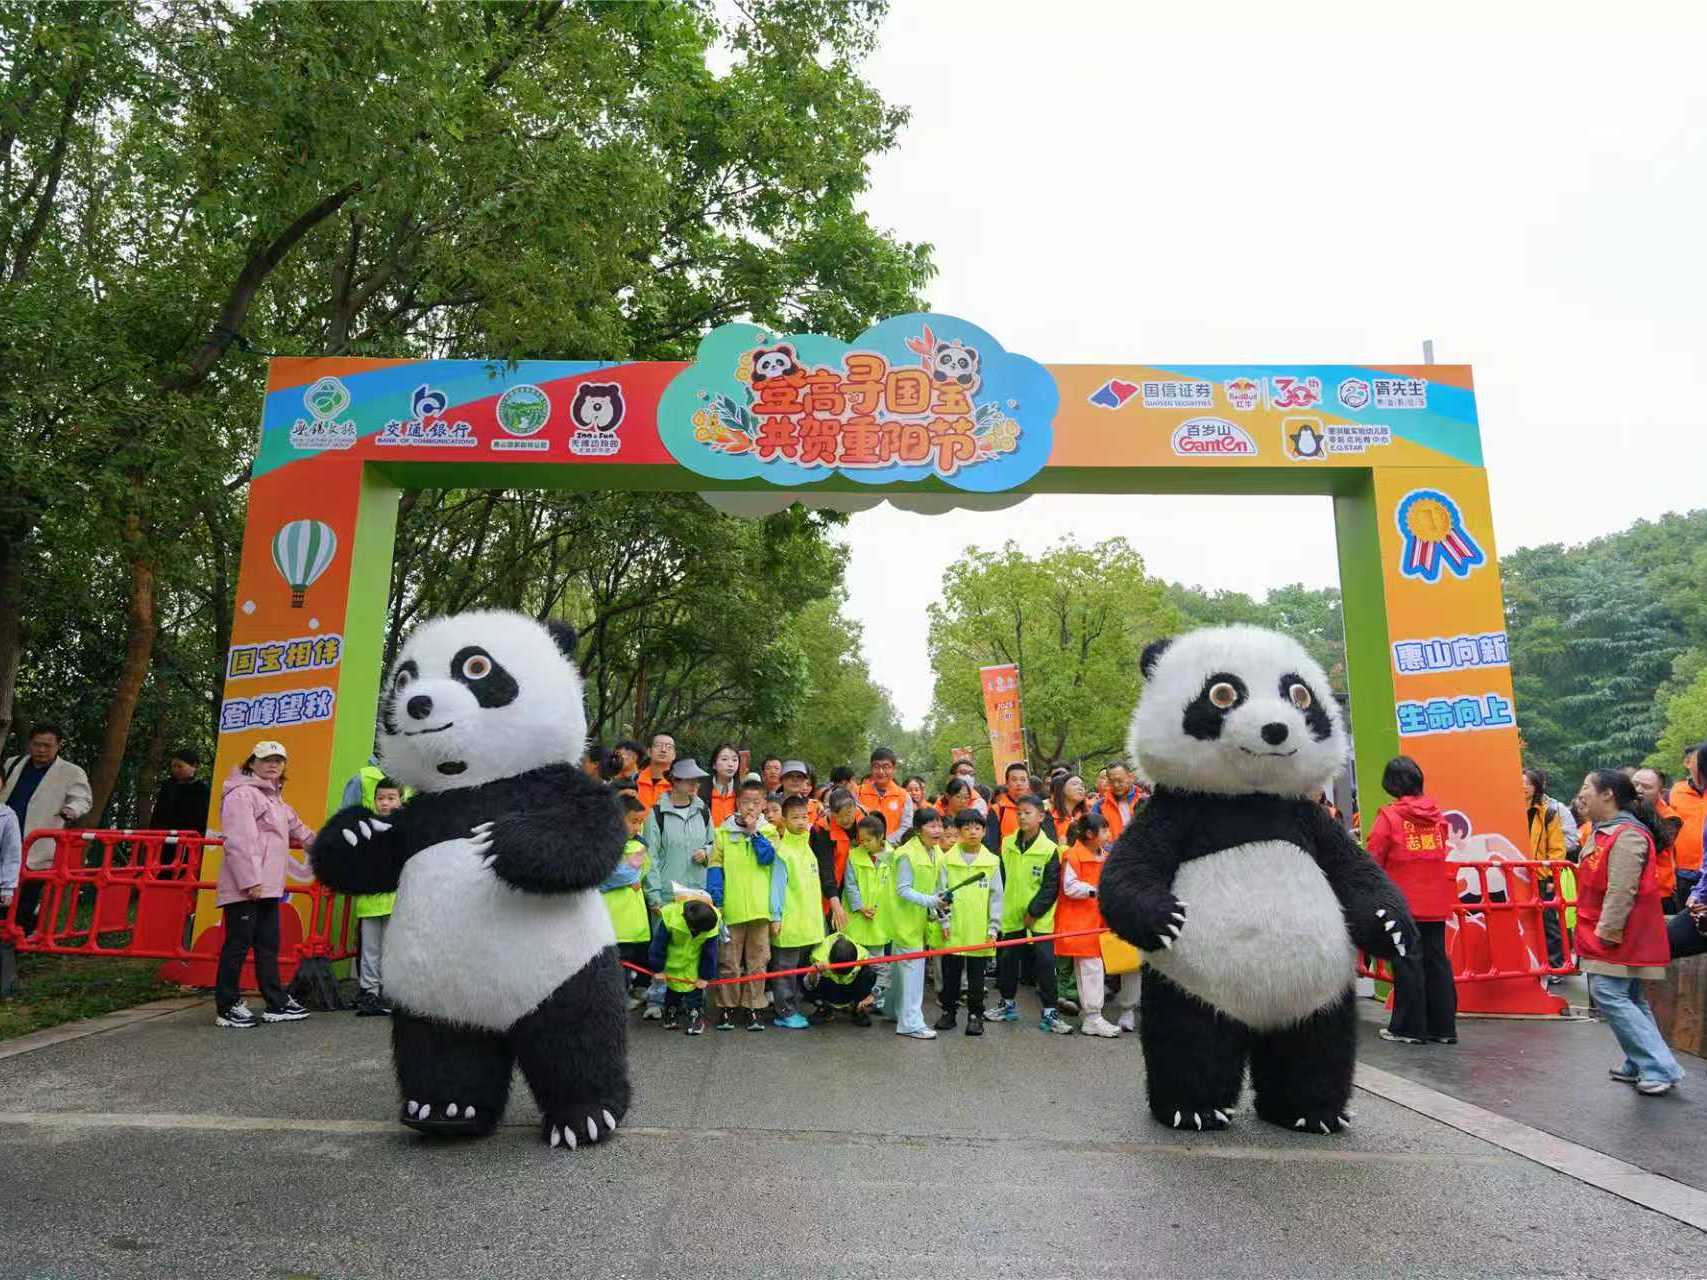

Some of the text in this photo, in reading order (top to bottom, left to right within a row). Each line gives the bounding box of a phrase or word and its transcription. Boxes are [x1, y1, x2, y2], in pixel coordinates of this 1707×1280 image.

[1144, 383, 1210, 398] 国信证券
[756, 414, 977, 471] 共贺重阳节
[1187, 424, 1232, 436] 百岁山
[229, 637, 342, 677] 国宝相伴
[1395, 634, 1508, 672] 惠山向新
[221, 690, 334, 731] 登峰望秋
[1398, 696, 1512, 734] 生命向上
